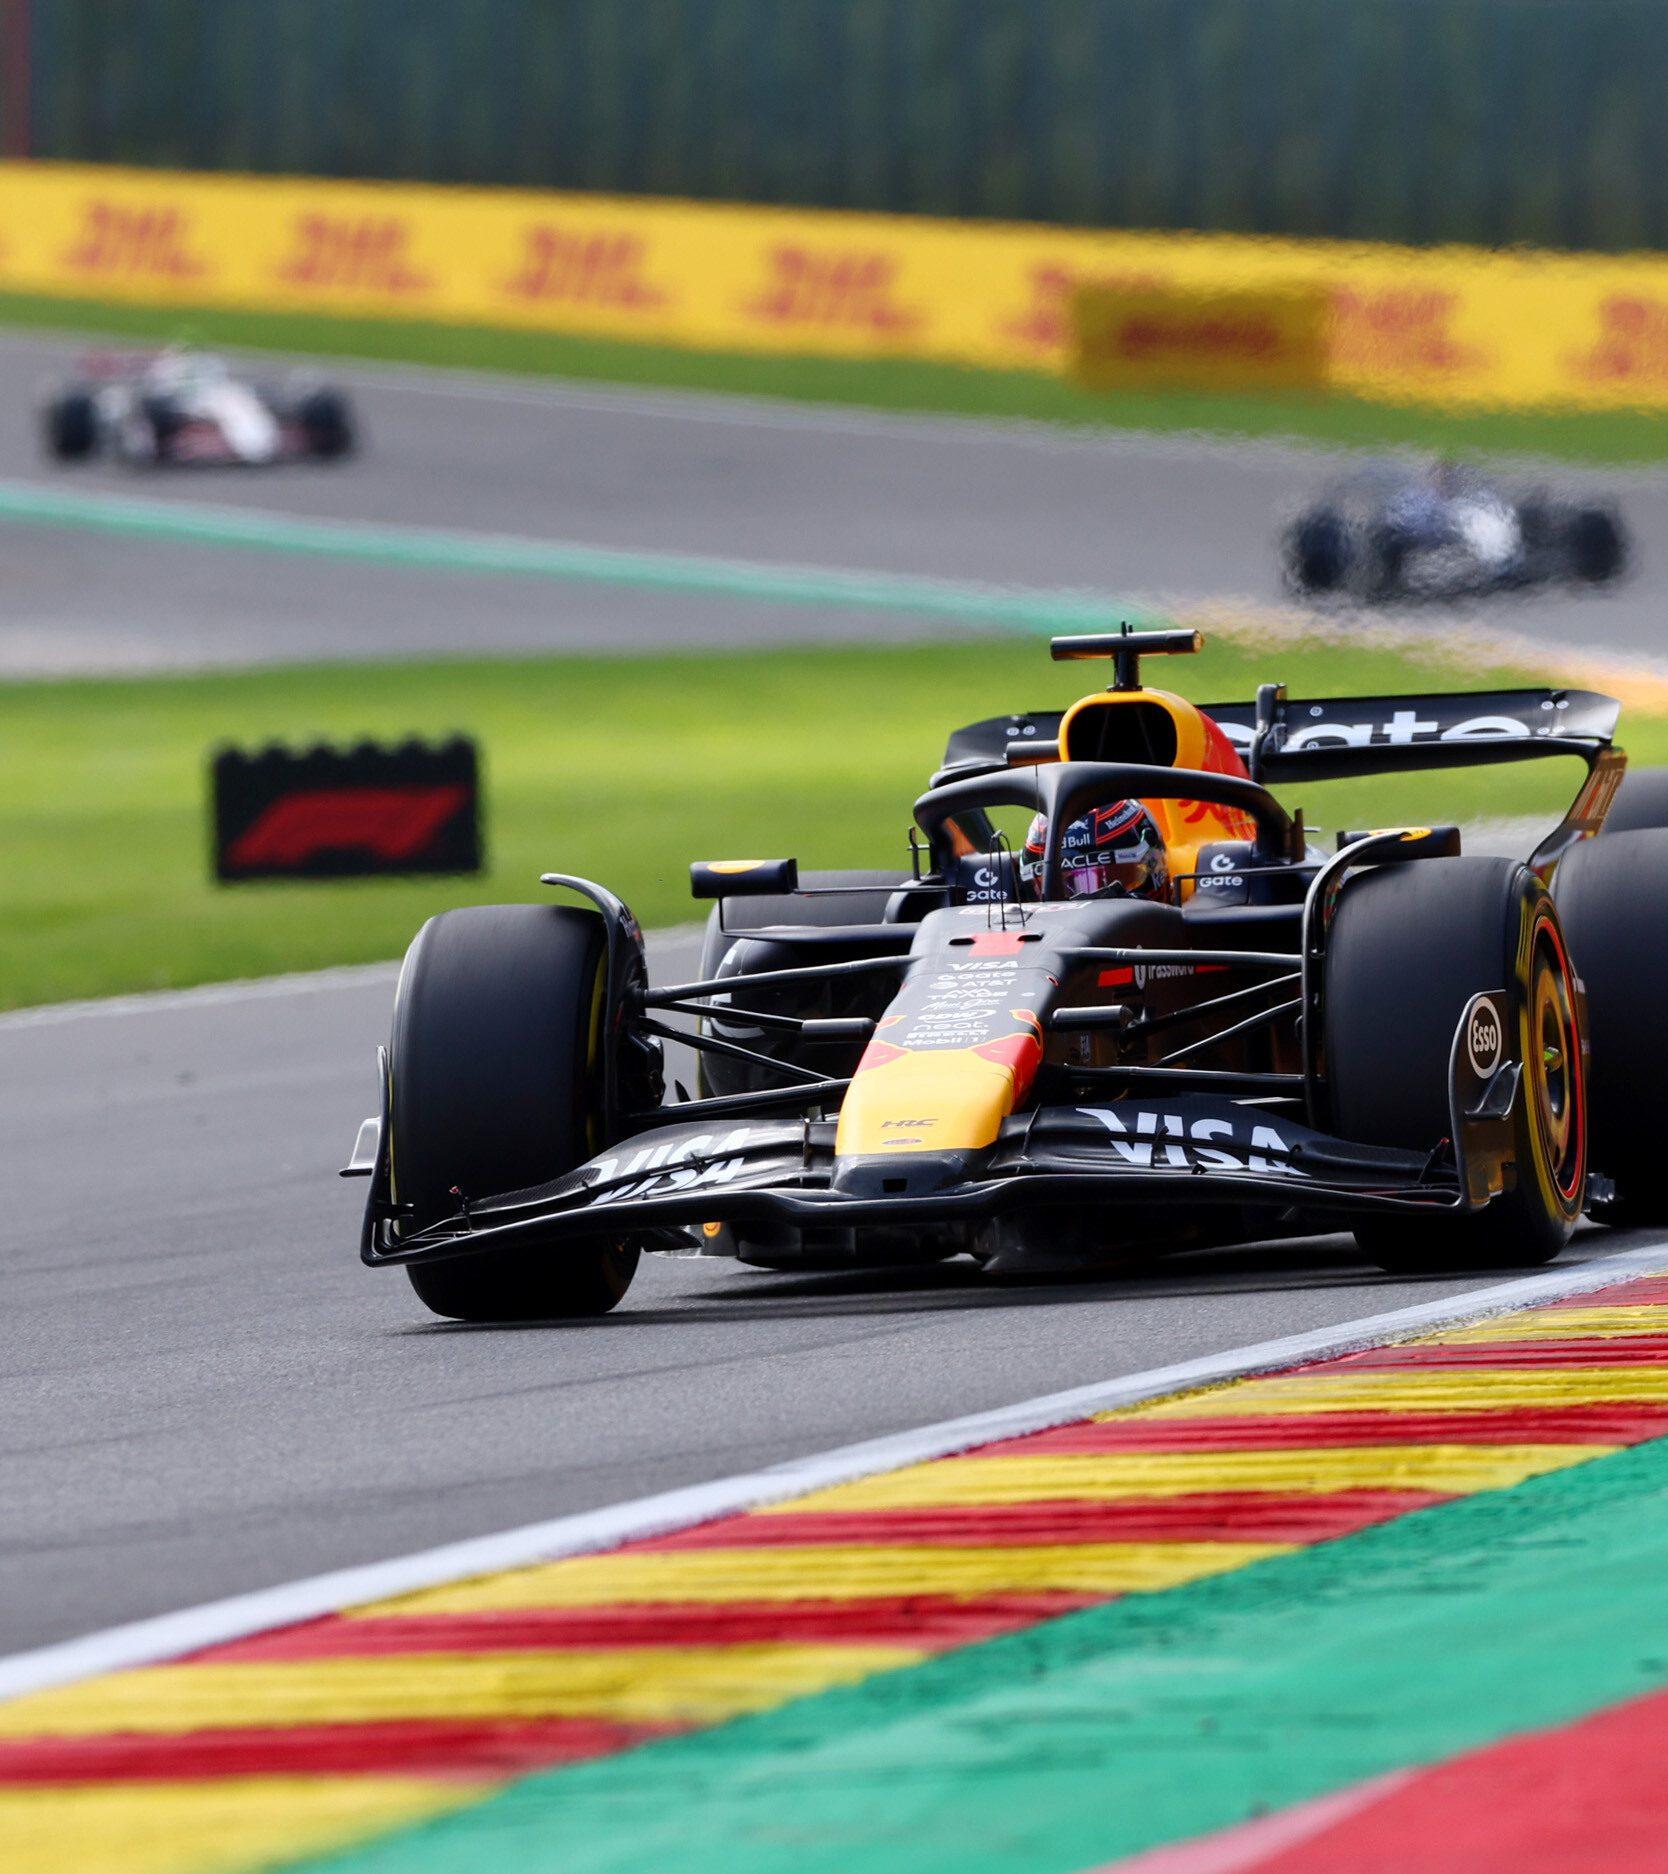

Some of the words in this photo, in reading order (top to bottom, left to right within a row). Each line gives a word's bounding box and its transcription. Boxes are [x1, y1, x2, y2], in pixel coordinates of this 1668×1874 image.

[1034, 852, 1112, 877] OACLE
[948, 961, 1019, 971] VISA
[1472, 1019, 1497, 1053] Esso
[1075, 1107, 1311, 1177] VISA
[590, 1127, 750, 1207] VISA
